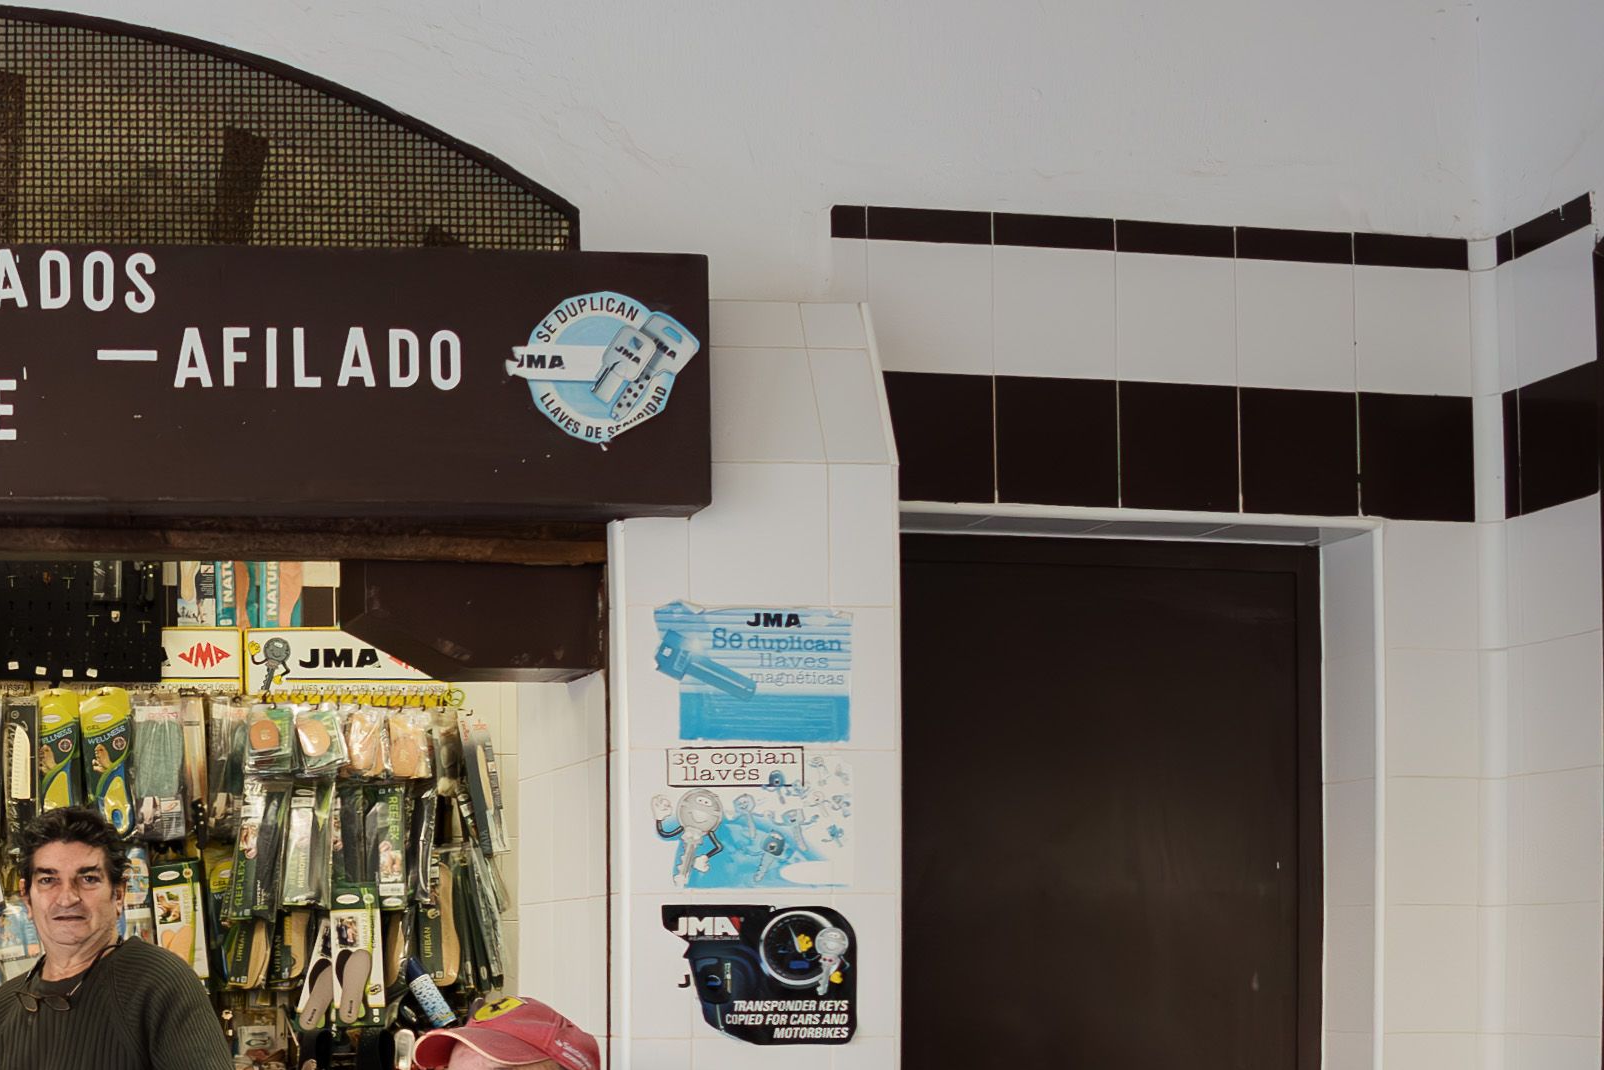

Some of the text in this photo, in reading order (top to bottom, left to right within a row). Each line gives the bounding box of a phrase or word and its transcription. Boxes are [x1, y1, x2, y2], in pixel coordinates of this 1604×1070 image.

[536, 296, 640, 343] SE DUPLICAN
[517, 353, 565, 369] JMA
[614, 344, 642, 365] JMA
[539, 392, 580, 434] LLAVES
[585, 426, 602, 438] DE
[746, 611, 803, 628] JMA
[711, 627, 844, 653] Se duplican
[178, 642, 232, 670] JMA
[299, 648, 381, 669] JMA
[759, 652, 830, 670] llaves
[749, 670, 845, 687] magnéticas
[87, 724, 127, 745] WELLNESS
[710, 748, 798, 768] copian
[681, 766, 760, 782] llaves
[388, 796, 401, 841] REFLEX
[234, 859, 247, 907] REFLEX
[671, 916, 741, 936] JMA
[424, 926, 433, 958] URBAN
[733, 1000, 849, 1011] TRANSPONDER KEYS
[725, 1013, 849, 1025] COPIED FOR CARS AND
[773, 1027, 849, 1039] MOTORBIKES
